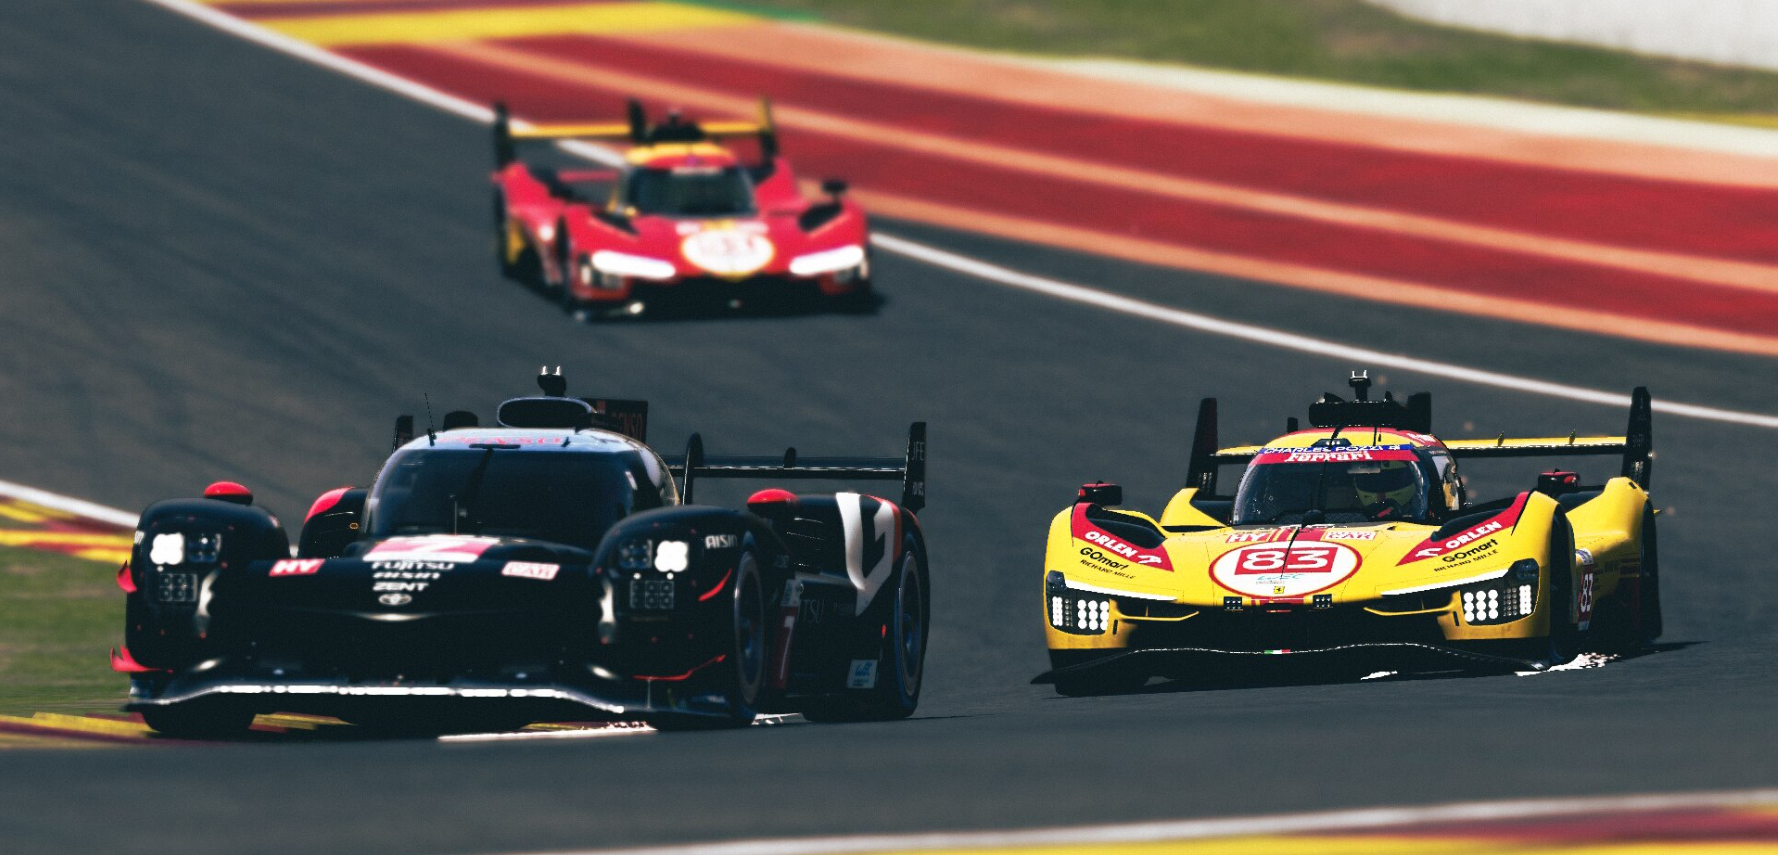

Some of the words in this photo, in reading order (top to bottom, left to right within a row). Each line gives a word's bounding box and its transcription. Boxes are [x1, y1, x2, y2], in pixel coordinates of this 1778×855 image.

[1264, 446, 1332, 454] CHARLES
[1284, 450, 1373, 462] Ferrari
[1228, 532, 1267, 542] HY
[1445, 521, 1502, 549] ORLEN
[1085, 531, 1138, 558] ORLEN
[1442, 539, 1498, 562] GOmart
[1080, 547, 1129, 570] GOmart
[1242, 549, 1330, 570] 83
[1473, 549, 1498, 562] MILLE
[274, 559, 320, 573] HY
[372, 560, 455, 570] FUJITSU
[373, 581, 429, 591] ZENT
